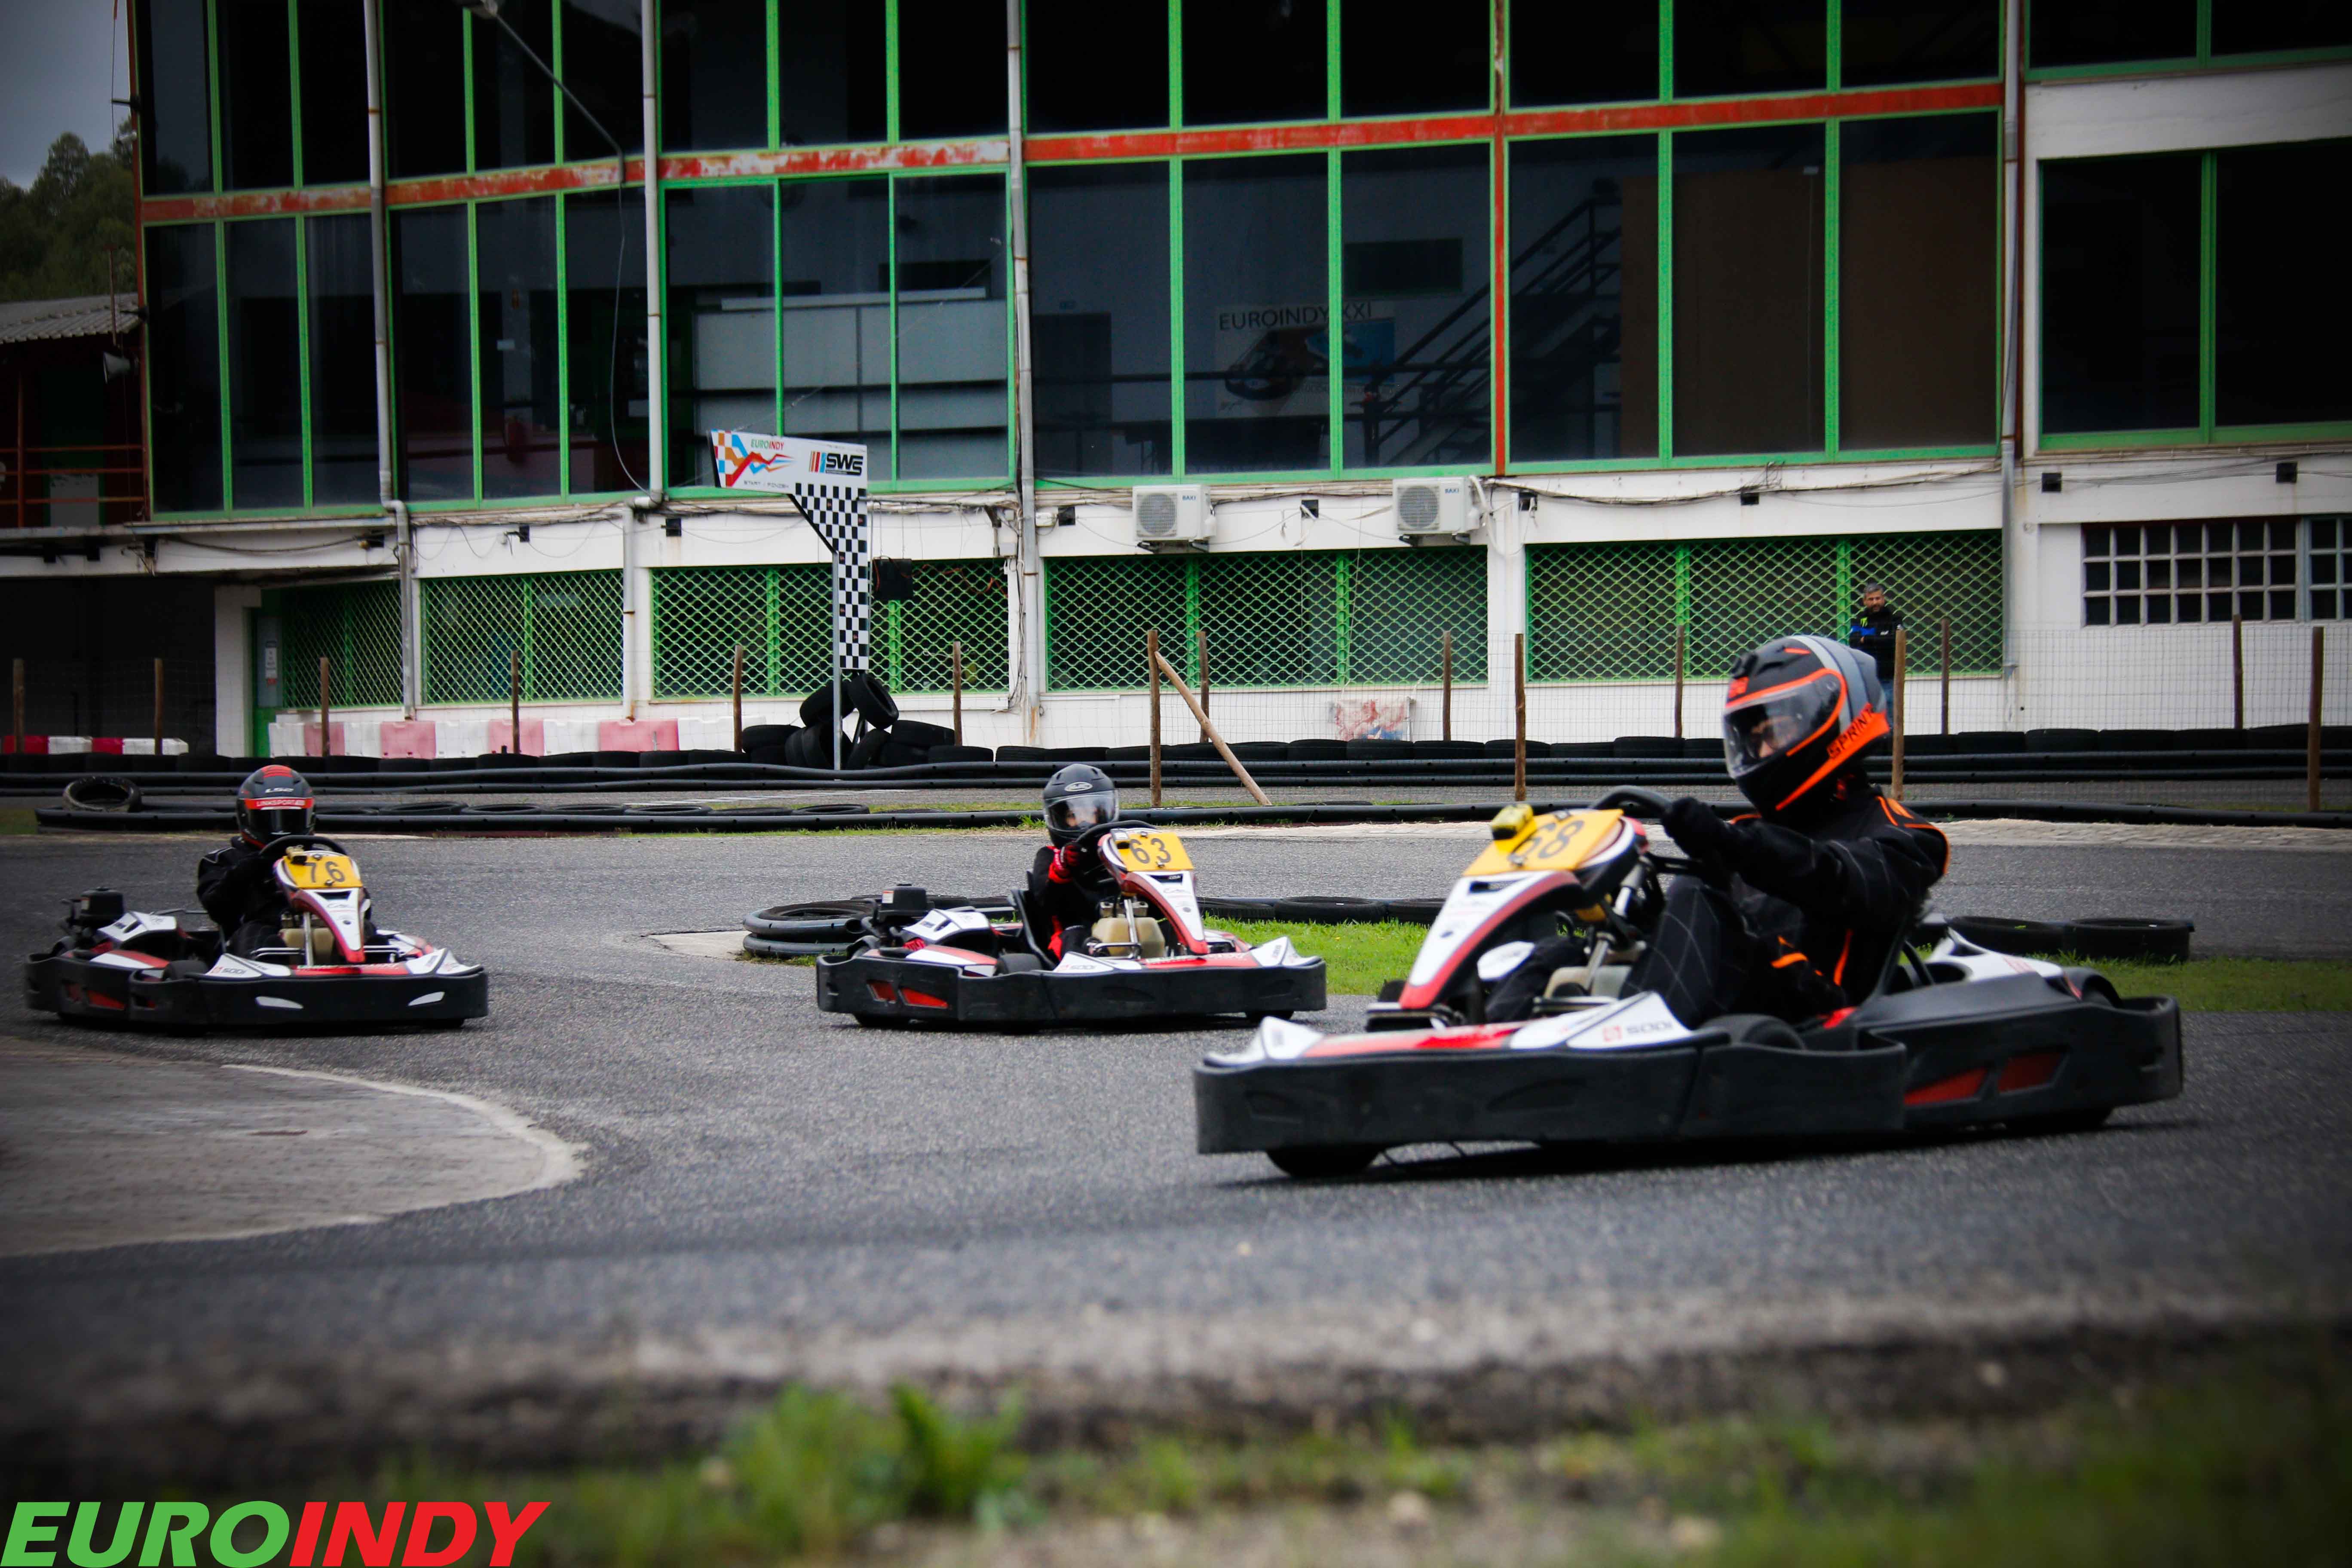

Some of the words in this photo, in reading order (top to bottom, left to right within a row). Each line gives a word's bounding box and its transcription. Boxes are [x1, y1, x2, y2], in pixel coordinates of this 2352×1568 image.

[1219, 306, 1329, 331] EUROINDY
[751, 439, 784, 450] EUROINDY
[826, 453, 863, 475] SWS
[1827, 706, 1877, 759] SPRINT
[1129, 838, 1171, 864] 63
[1510, 820, 1585, 859] 68
[303, 861, 345, 883] 76
